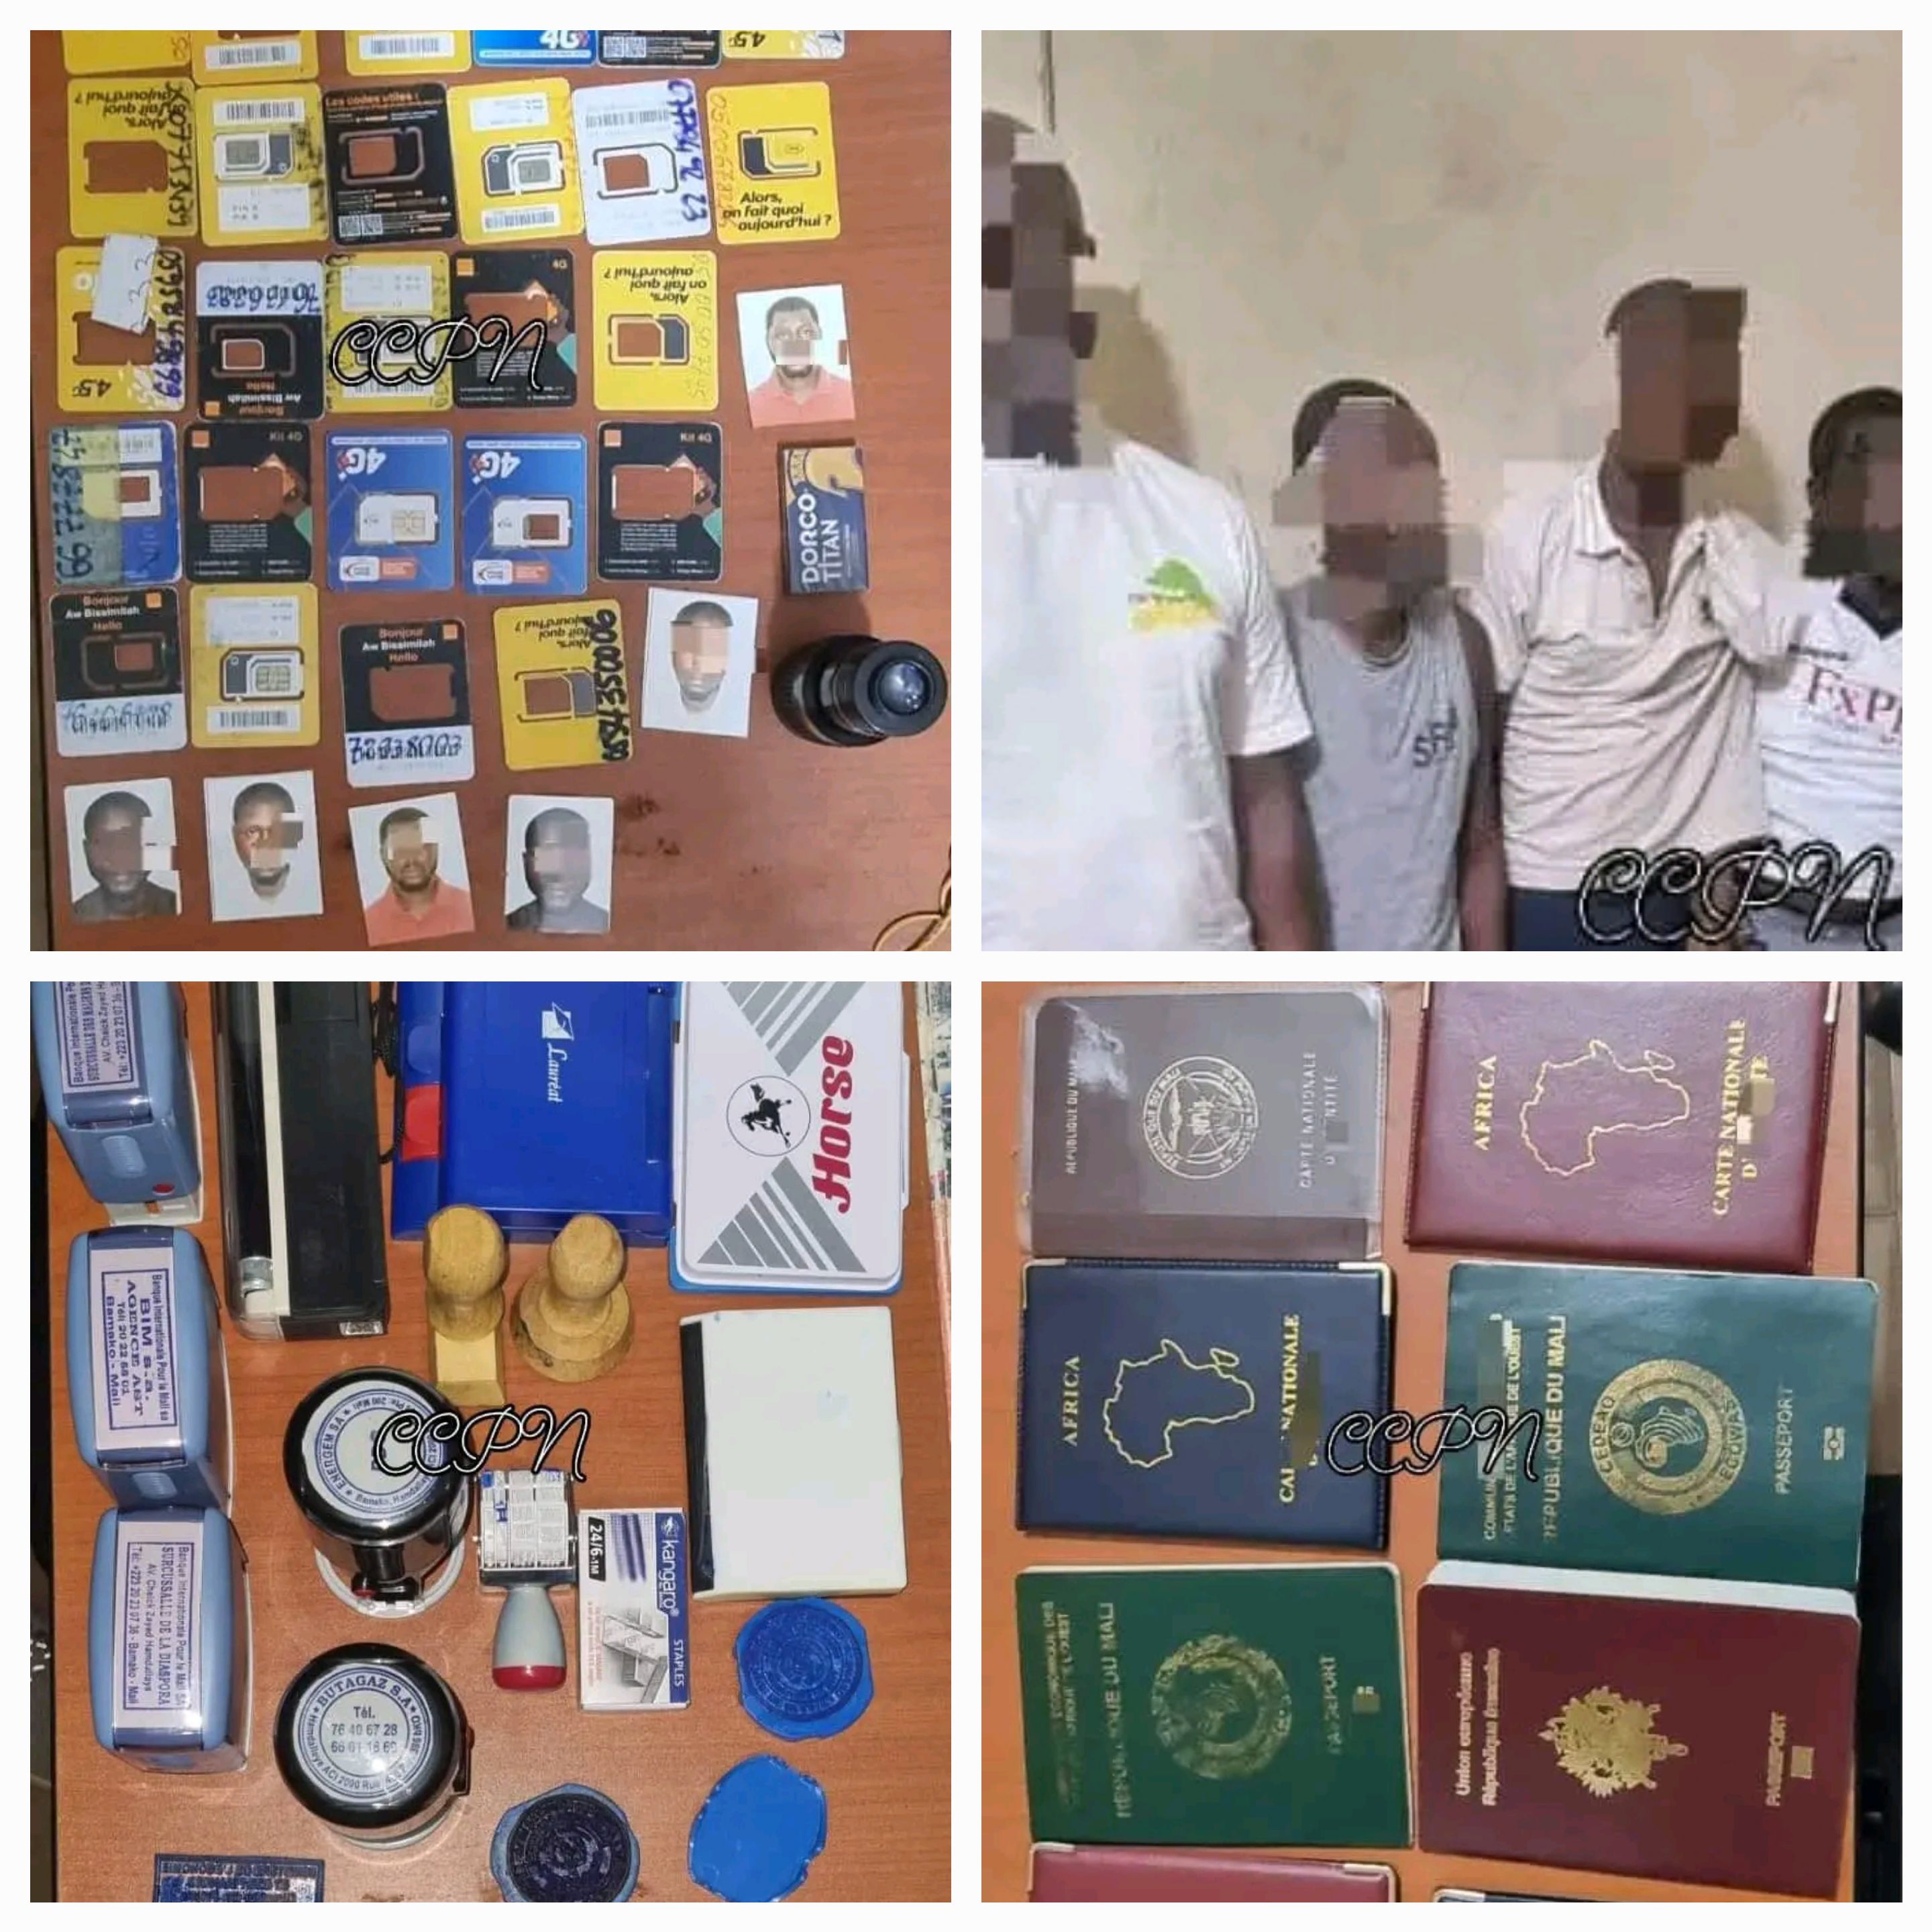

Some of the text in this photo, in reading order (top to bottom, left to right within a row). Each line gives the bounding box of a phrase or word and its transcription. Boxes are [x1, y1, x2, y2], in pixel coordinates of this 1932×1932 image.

[740, 191, 783, 204] Alors,
[744, 205, 770, 217] fait
[771, 202, 804, 218] quoi
[796, 494, 820, 584] DORCO
[817, 519, 843, 584] TITAN
[811, 1036, 854, 1214] Horse
[1473, 1055, 1497, 1150] AFRICA
[1712, 1018, 1746, 1216] CARTE NATIONALE
[107, 1295, 117, 1358] Bamako
[140, 1298, 153, 1346] BIM
[1062, 1356, 1080, 1447] AFRICA
[1546, 1373, 1564, 1403] DU
[1774, 1387, 1794, 1495] PASSEPORT
[159, 1620, 172, 1633] DE
[158, 1653, 172, 1705] DIASPORA
[672, 1638, 685, 1687] STAPLES
[317, 1675, 389, 1707] BUTAGAZ
[331, 1723, 345, 1736] 76
[383, 1723, 398, 1737] 28
[1454, 1750, 1471, 1796] Union
